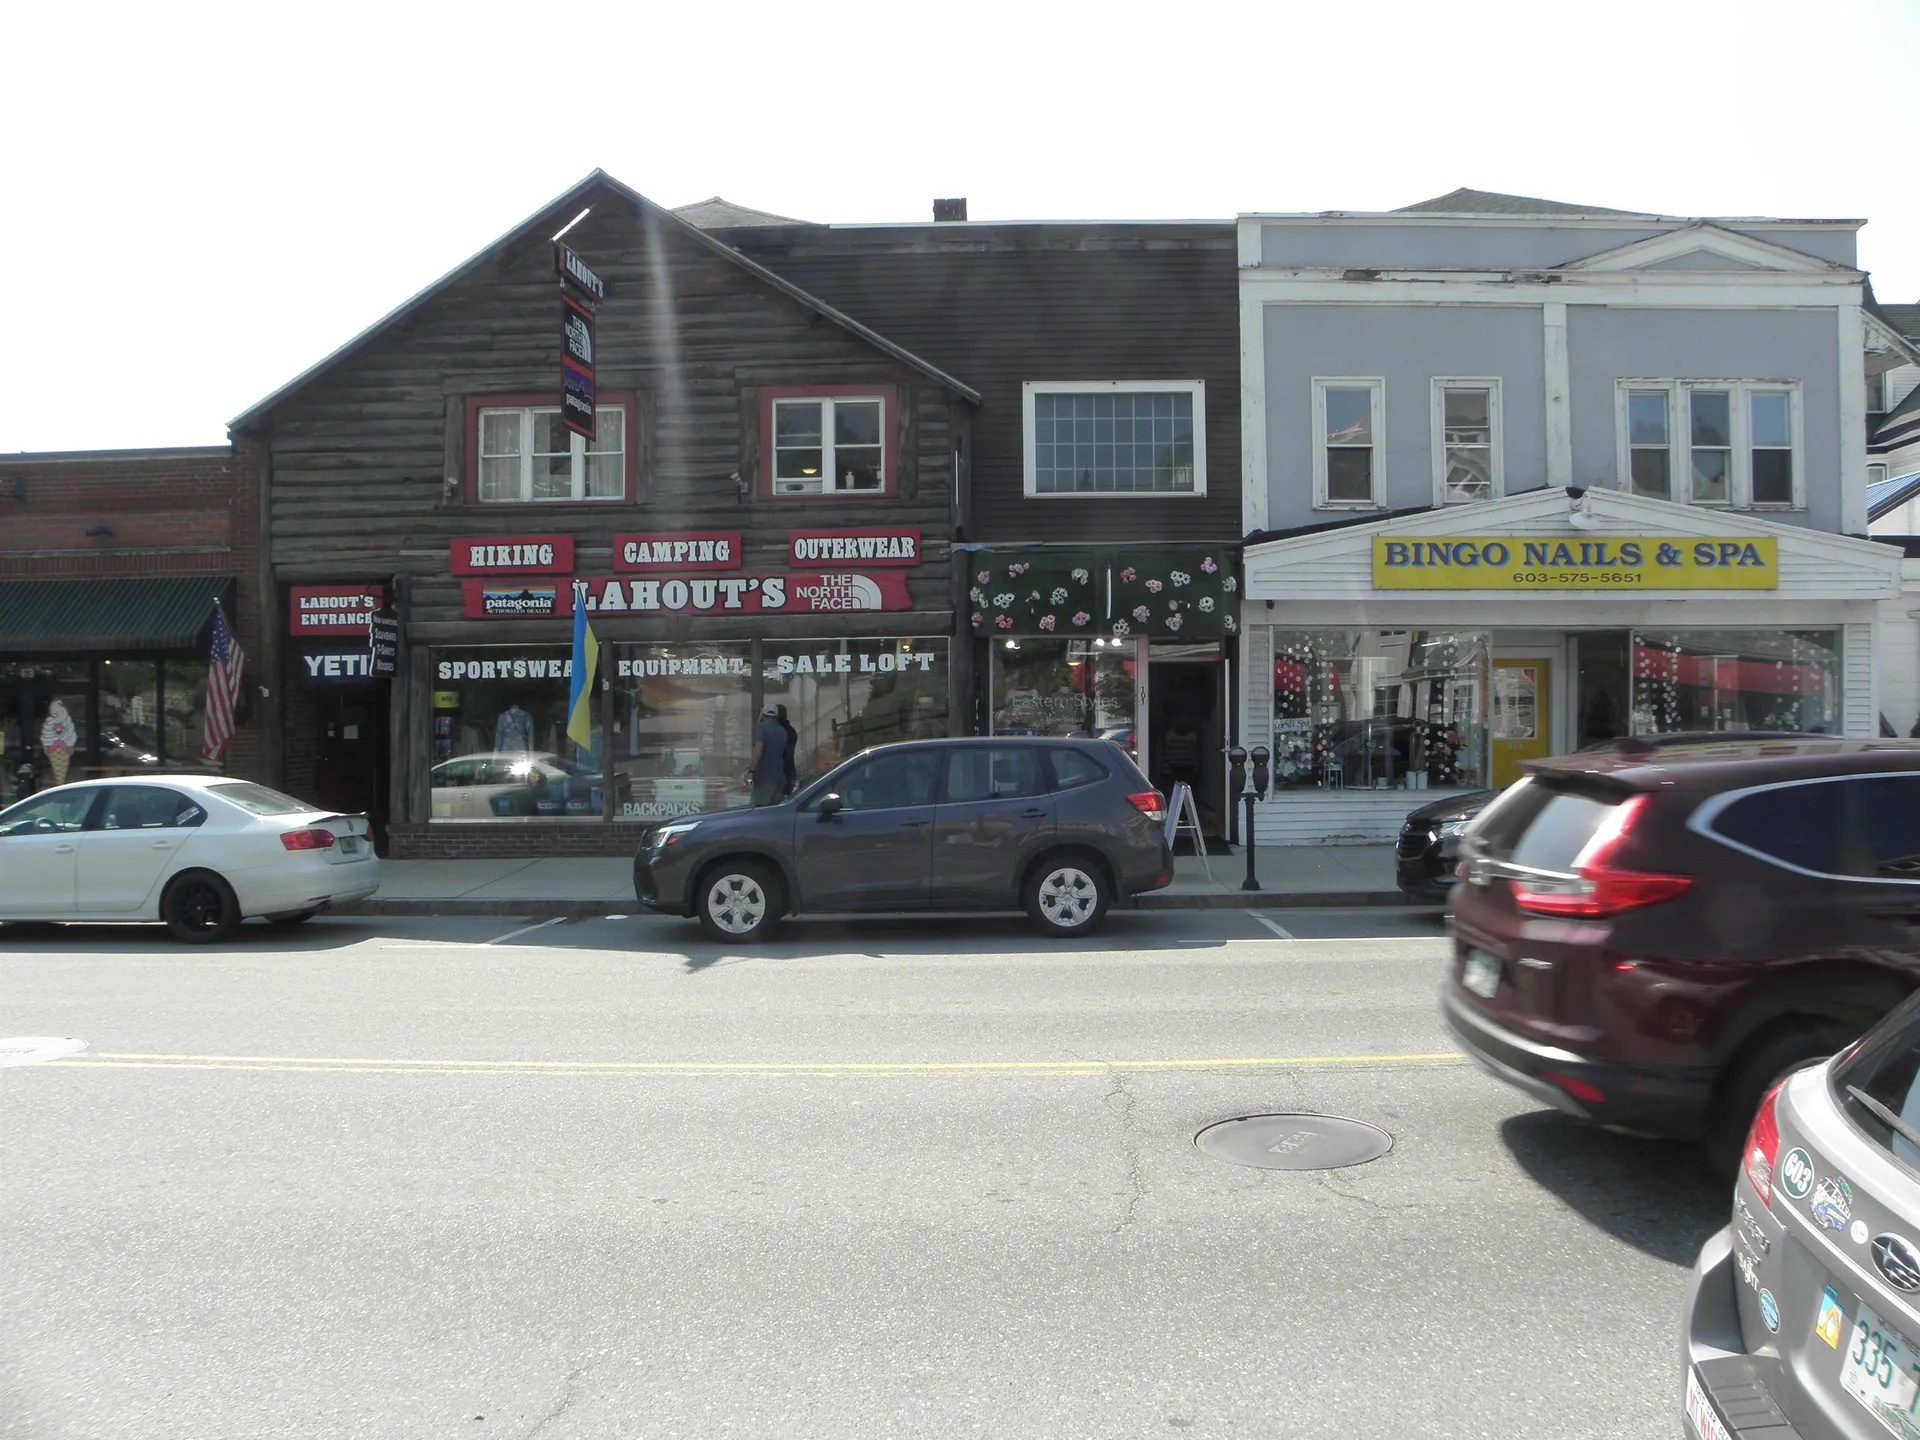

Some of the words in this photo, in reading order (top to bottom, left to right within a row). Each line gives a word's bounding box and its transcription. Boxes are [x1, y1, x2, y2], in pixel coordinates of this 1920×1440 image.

[566, 250, 604, 298] LAHOUT'S
[572, 315, 584, 331] THE
[565, 322, 584, 347] NORTH
[569, 338, 584, 358] FACE
[566, 394, 592, 415] patagonia
[470, 544, 554, 567] HIKING
[624, 541, 730, 563] CAMPING
[794, 537, 916, 559] OUTERWEAR
[1384, 542, 1511, 567] BINGO
[1523, 542, 1644, 567] NAILS
[1655, 543, 1683, 567] &
[1693, 543, 1767, 567] SPA
[820, 575, 852, 586] THE
[1512, 572, 1642, 583] 603-575-5651
[300, 595, 375, 608] LAHOUT'S
[572, 578, 786, 612] LAHOUT'S
[796, 586, 852, 598] NORTH
[486, 598, 552, 613] patagonia
[811, 598, 852, 610] FACE
[301, 613, 372, 625] ENTRANCE
[304, 655, 368, 676] YETI
[438, 660, 573, 680] SPORTSWEA
[618, 658, 744, 678] EQUIPMENT
[777, 654, 851, 674] SALE
[860, 653, 934, 672] LOFT
[1012, 693, 1070, 709] Eastern
[1074, 693, 1119, 710] Styles
[624, 802, 700, 817] BACKPACKS
[1784, 1153, 1812, 1192] 603
[1853, 1319, 1894, 1389] 335
